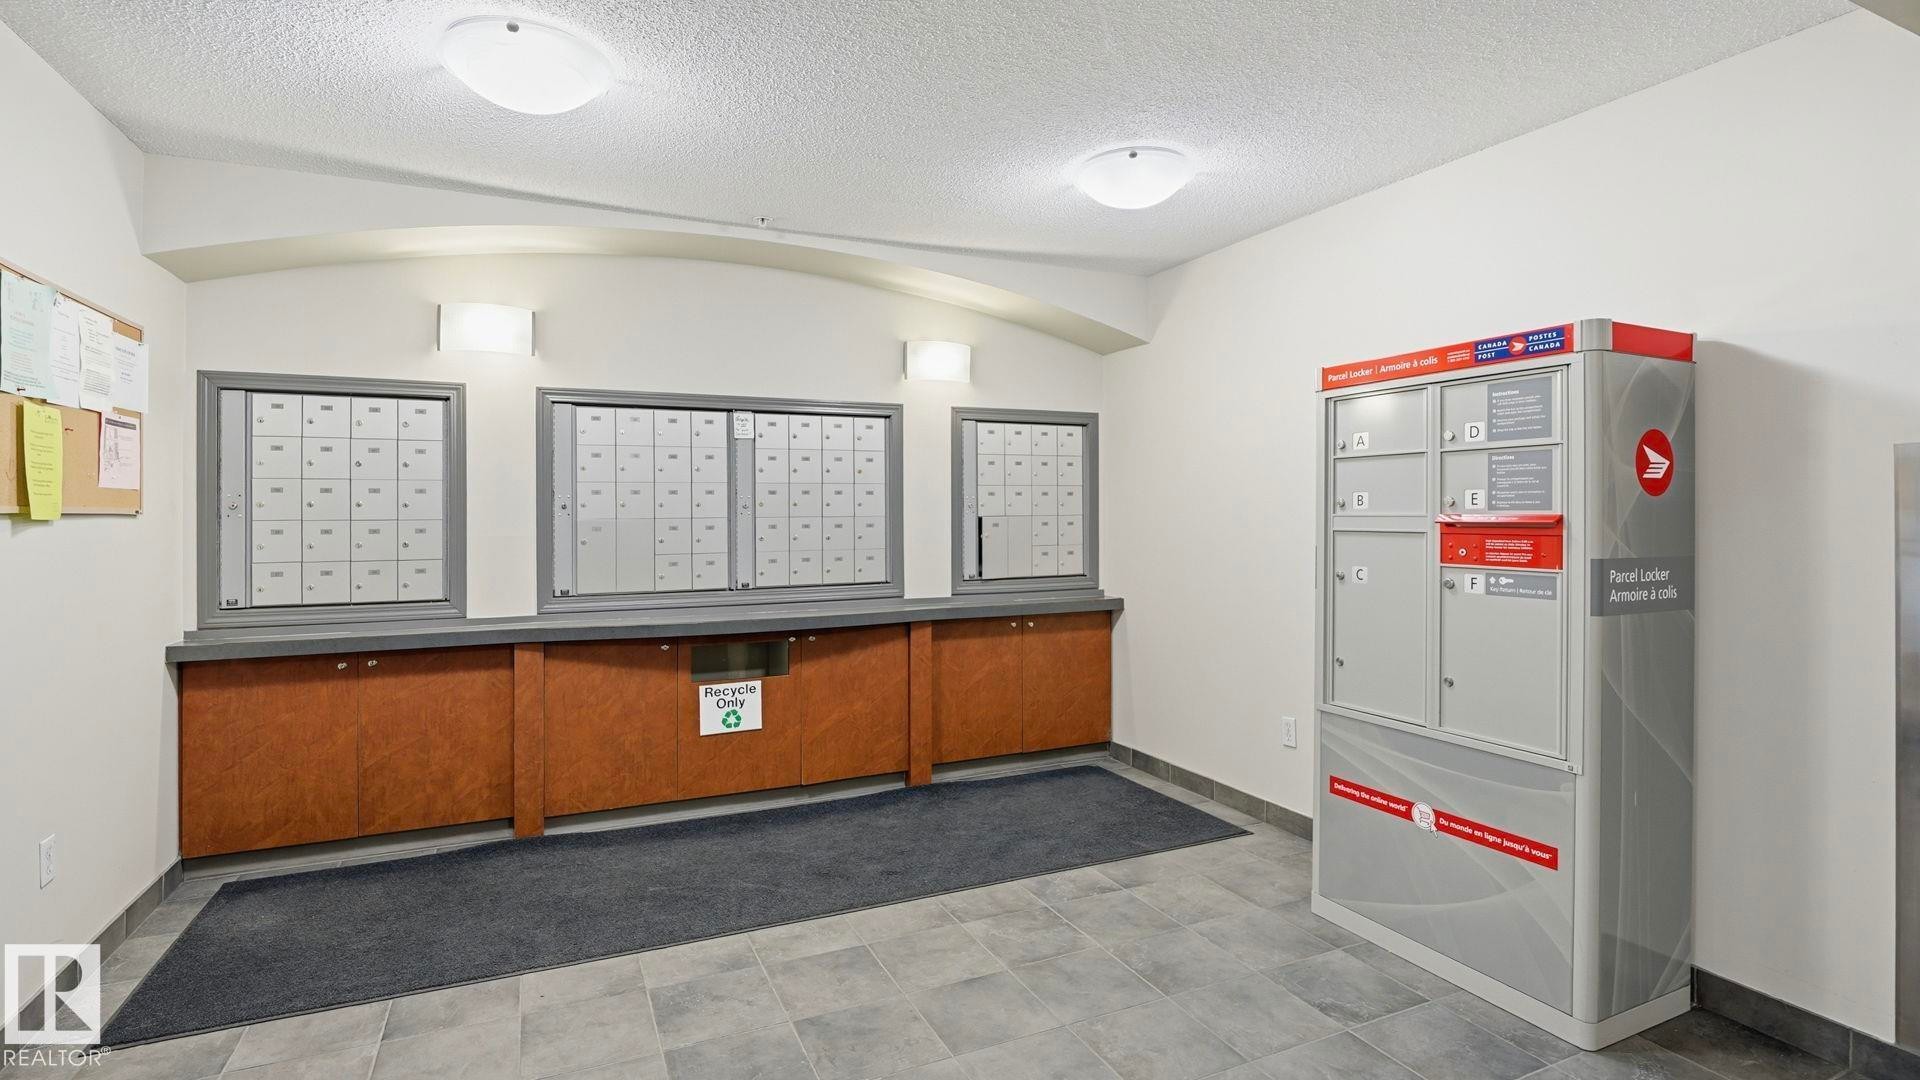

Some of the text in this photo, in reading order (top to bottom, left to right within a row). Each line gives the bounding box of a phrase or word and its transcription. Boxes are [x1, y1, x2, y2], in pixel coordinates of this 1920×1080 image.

[1528, 332, 1557, 341] POSTES
[1478, 340, 1507, 350] CANADA
[1529, 342, 1560, 352] CANADA
[1478, 352, 1495, 360] POST
[1379, 361, 1411, 373] Armoire
[1420, 356, 1438, 366] colis
[1328, 368, 1373, 382] Parcel Locker
[1469, 425, 1480, 438] D
[1356, 435, 1366, 447] A
[1357, 494, 1364, 507] B
[1471, 492, 1478, 505] E
[1356, 568, 1364, 581] C
[1610, 567, 1670, 583] Parcel Locker
[1470, 577, 1478, 590] F
[1609, 584, 1678, 603] Armoire à colis
[704, 684, 757, 698] Recycle
[716, 697, 745, 709] Only
[1333, 782, 1360, 798] Delivering
[1360, 792, 1370, 800] the
[1370, 796, 1388, 806] online
[1439, 817, 1449, 826] Du
[1449, 821, 1473, 834] monde
[1474, 829, 1483, 838] en
[1484, 831, 1502, 844] ligne
